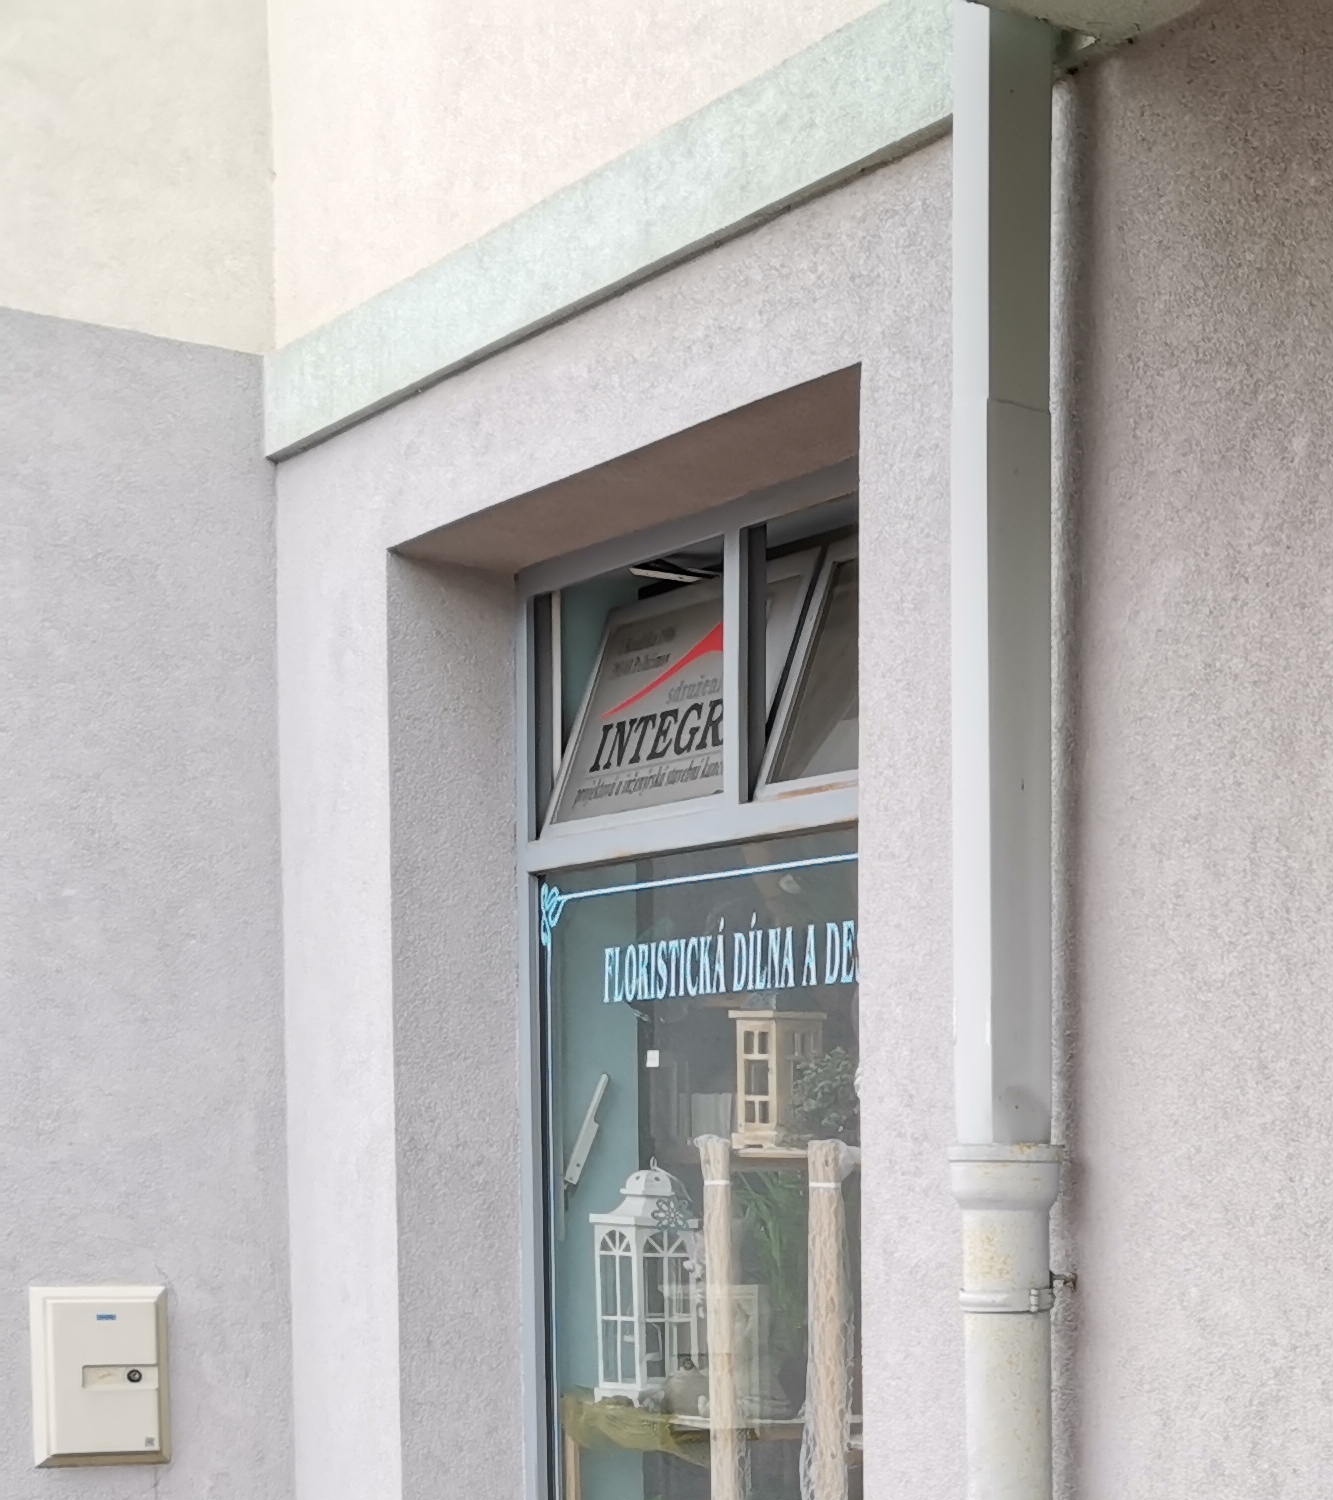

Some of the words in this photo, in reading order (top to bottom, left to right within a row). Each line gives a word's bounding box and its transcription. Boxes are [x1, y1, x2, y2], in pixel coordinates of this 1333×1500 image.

[589, 698, 723, 773] INTEGR
[603, 916, 726, 1003] FLORISTICKÁ
[732, 911, 795, 992] DÍLNA
[801, 924, 818, 987] A
[825, 920, 859, 985] DE
